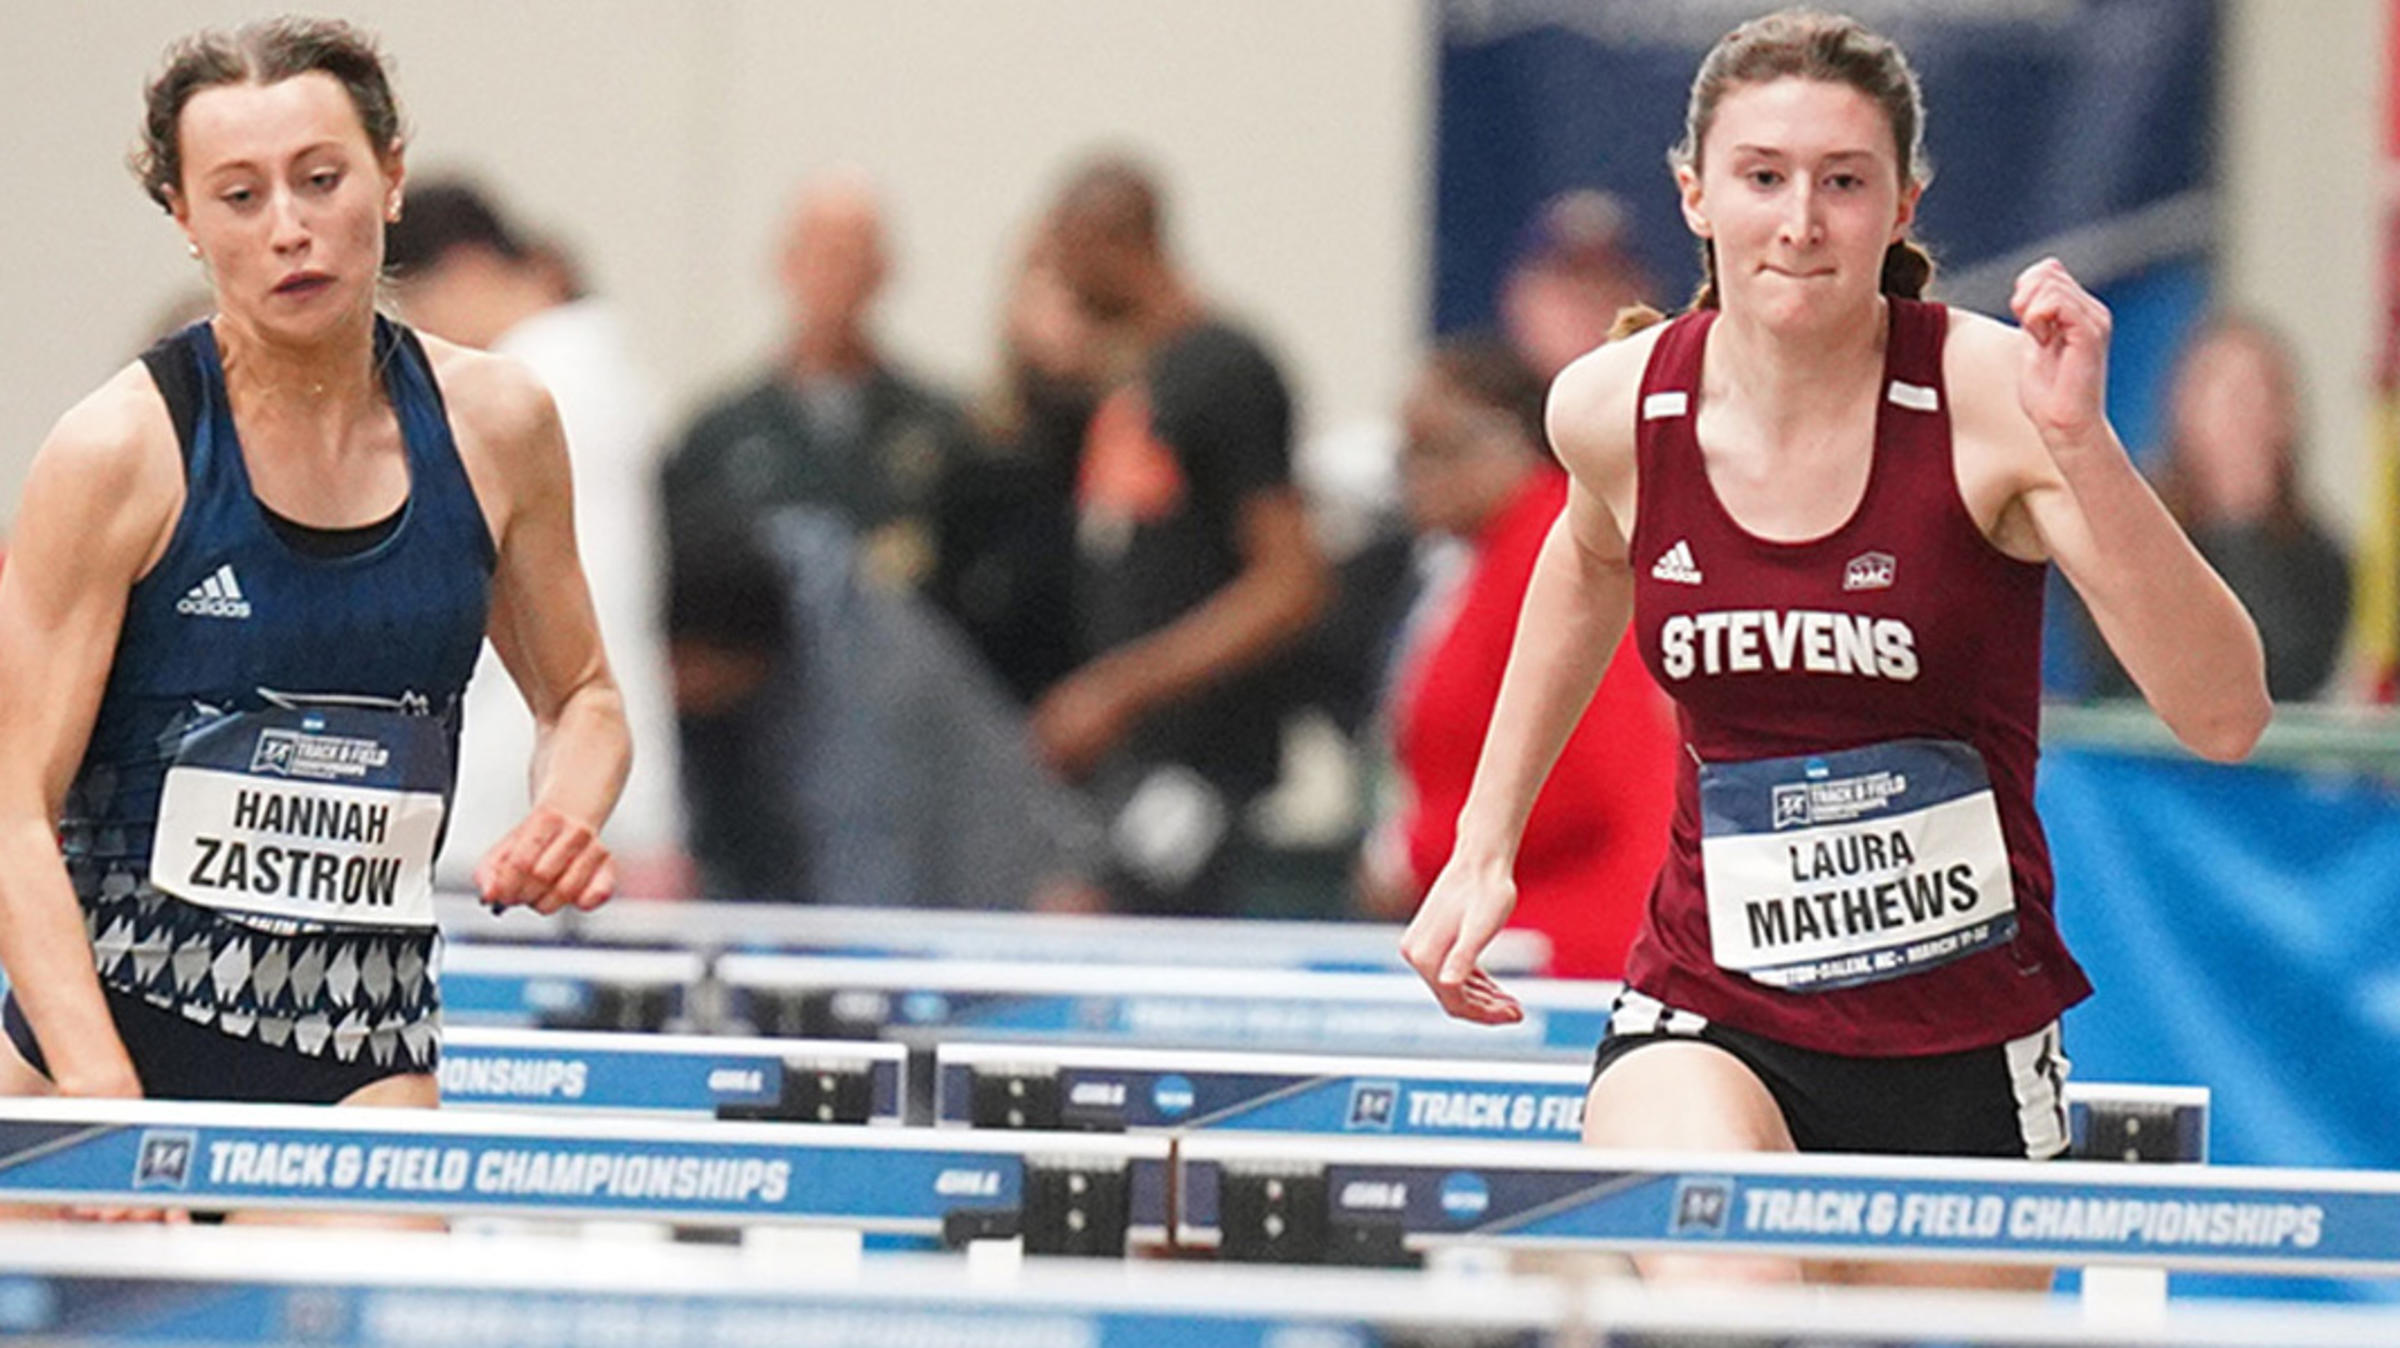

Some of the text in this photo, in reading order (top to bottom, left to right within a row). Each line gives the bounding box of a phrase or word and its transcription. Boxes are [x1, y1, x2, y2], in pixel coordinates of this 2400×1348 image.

[176, 598, 251, 618] adidas
[1661, 609, 1919, 681] STEVENS
[233, 789, 389, 844] HANNAH
[189, 837, 402, 906] ZASTROW
[1789, 830, 1915, 882] LAURA
[1745, 863, 1979, 948] MATHEWS
[438, 1056, 588, 1098] IONSHIPS
[1408, 1090, 1510, 1128] TRACK
[209, 1140, 334, 1187] TRACK
[365, 1146, 471, 1192] FIELD
[475, 1149, 791, 1202] CHAMPIONSHIPS
[1744, 1188, 1867, 1235] TRACK
[1900, 1193, 2005, 1239] FIELD
[2008, 1197, 2324, 1248] CHAMPIONSHIPS
